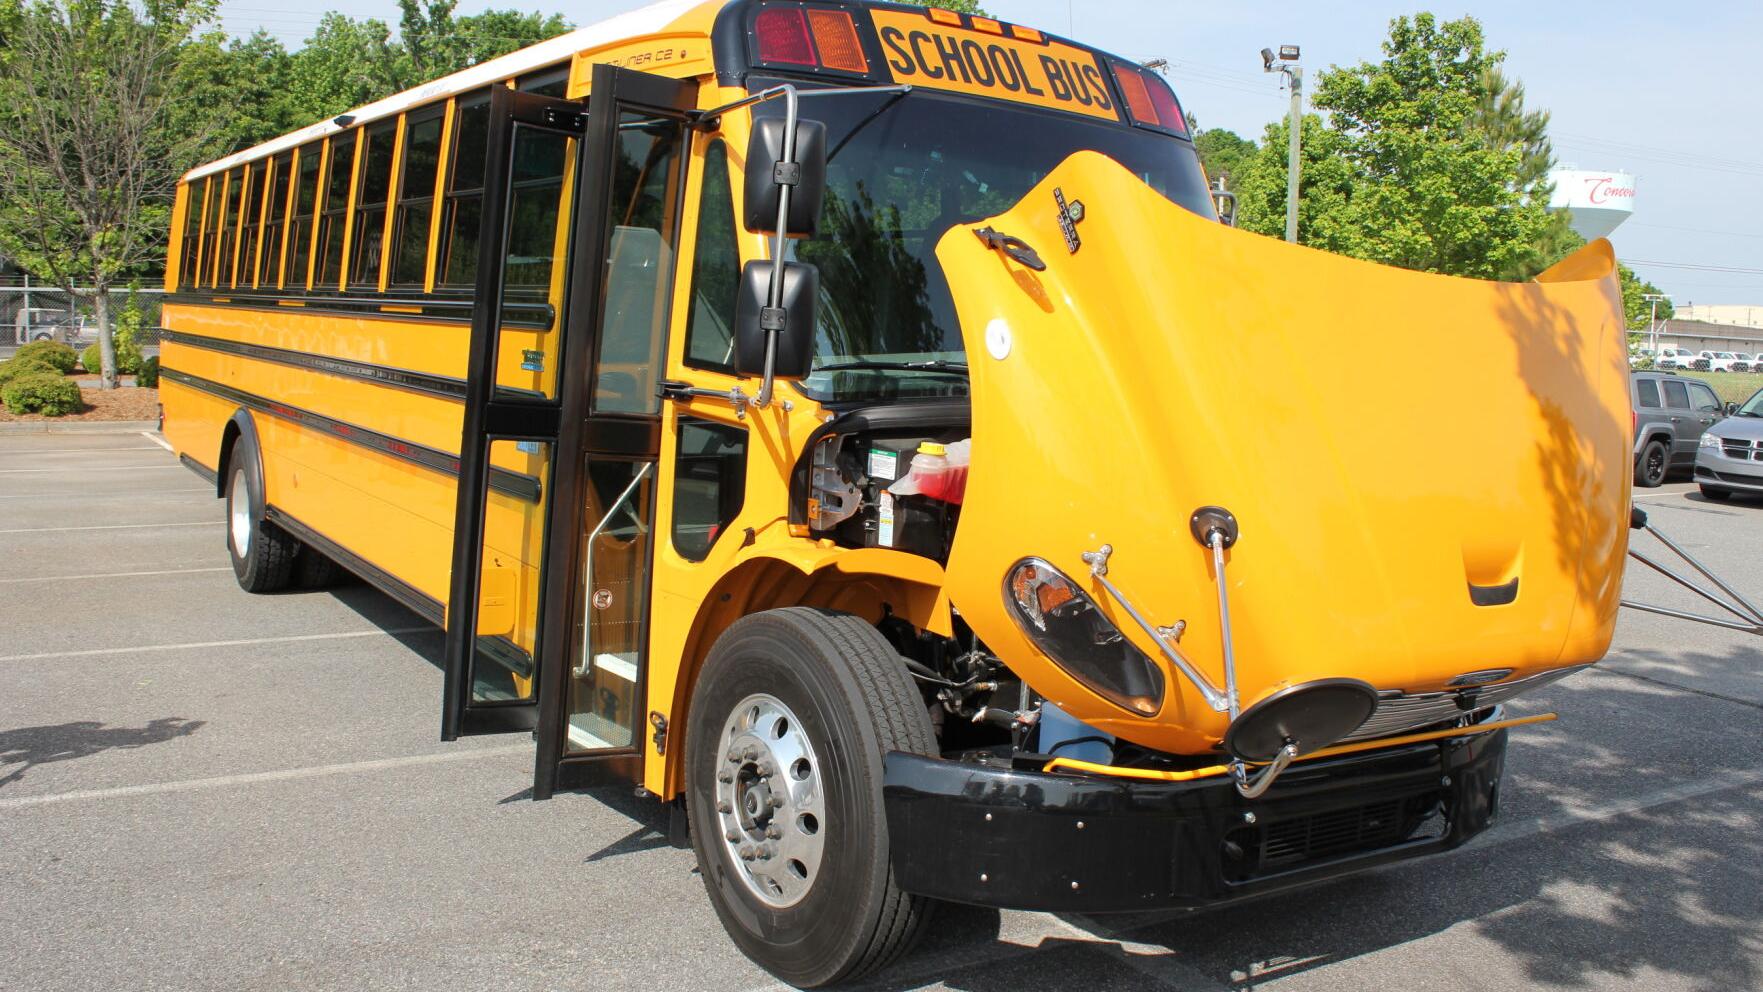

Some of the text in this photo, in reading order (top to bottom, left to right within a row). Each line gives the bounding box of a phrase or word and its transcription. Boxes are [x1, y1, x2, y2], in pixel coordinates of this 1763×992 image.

[655, 48, 673, 62] C2
[880, 26, 1112, 111] SCHOOL BUS
